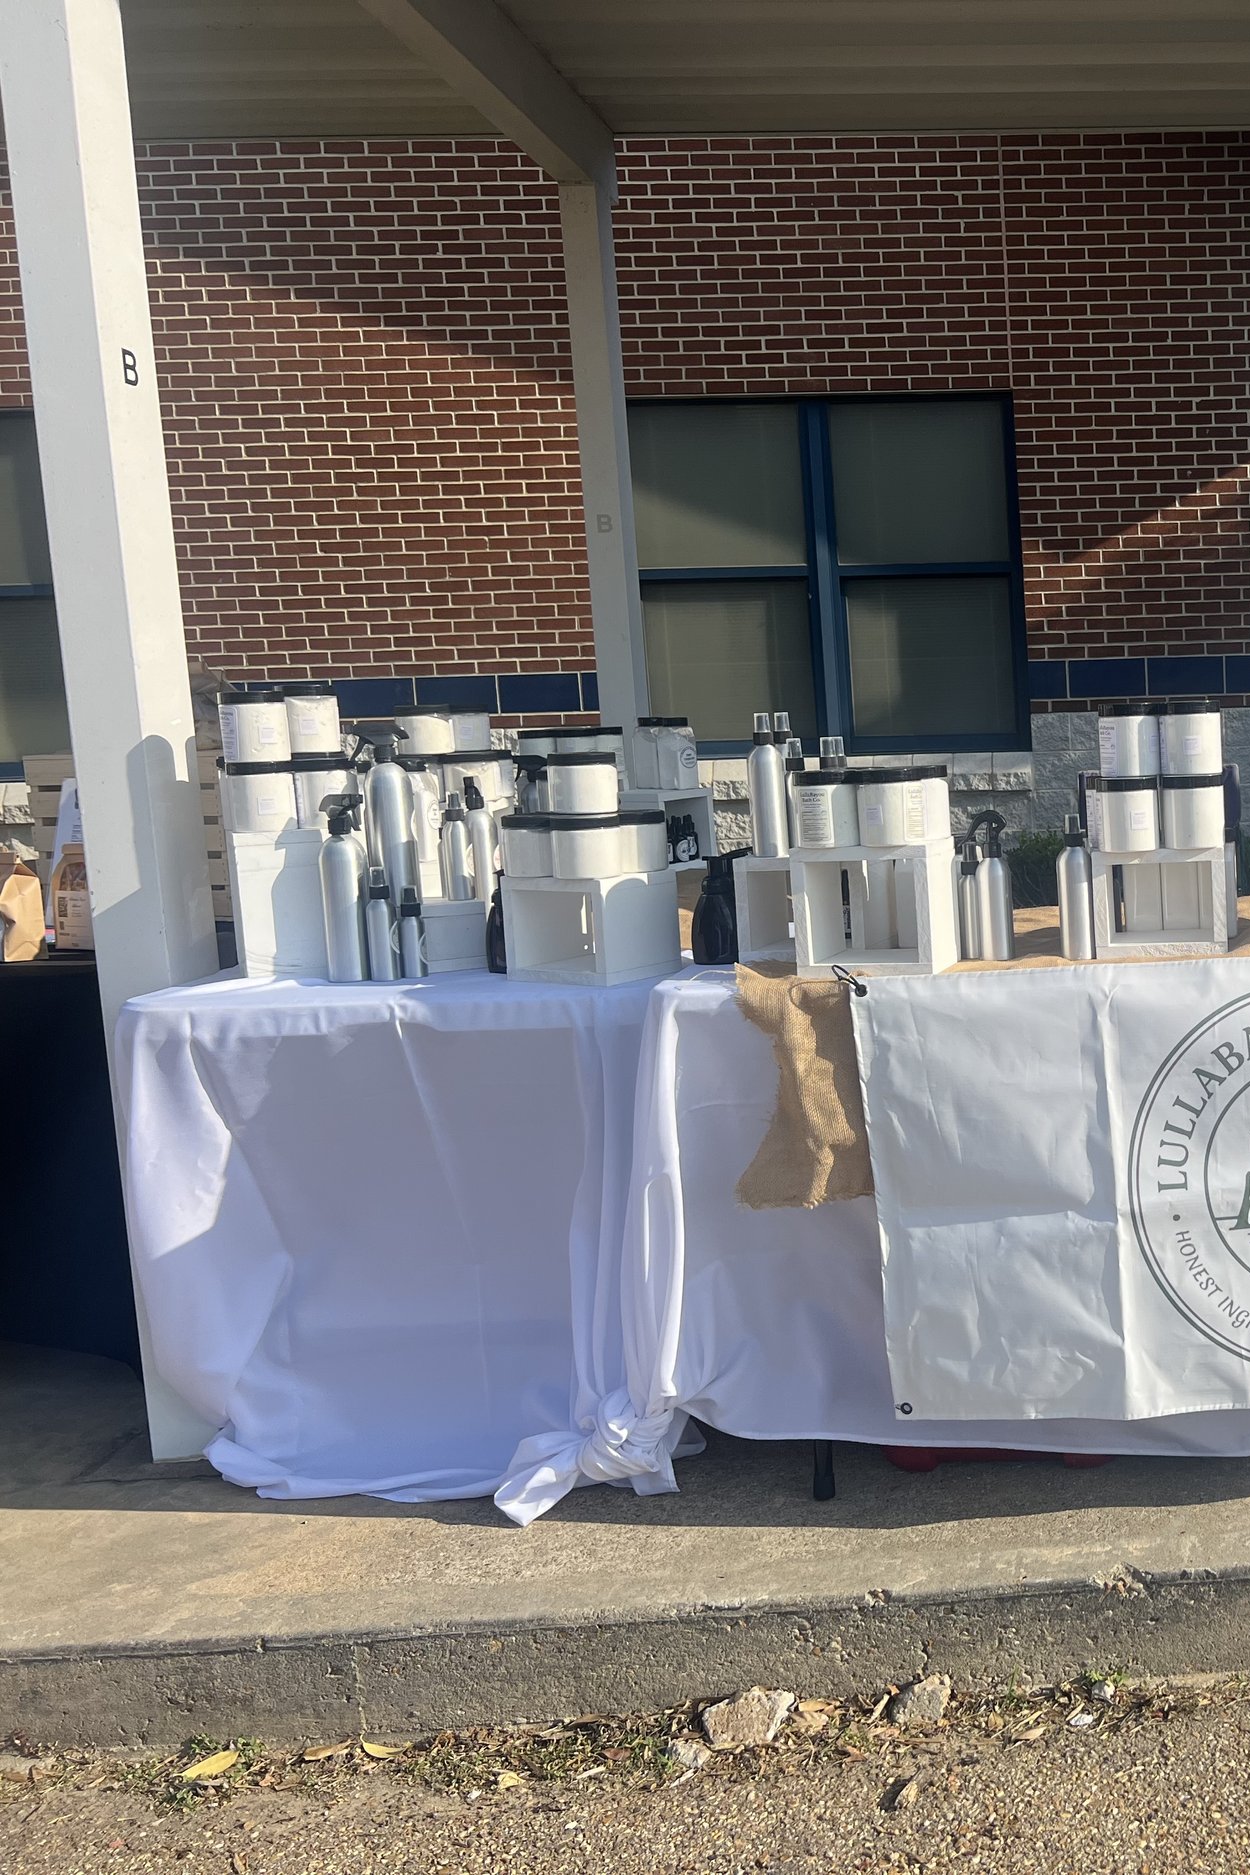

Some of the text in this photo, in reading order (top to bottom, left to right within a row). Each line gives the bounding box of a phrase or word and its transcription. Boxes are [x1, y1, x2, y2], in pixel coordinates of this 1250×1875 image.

[121, 348, 139, 386] B
[597, 514, 613, 533] B
[1176, 1230, 1223, 1297] HONEST
